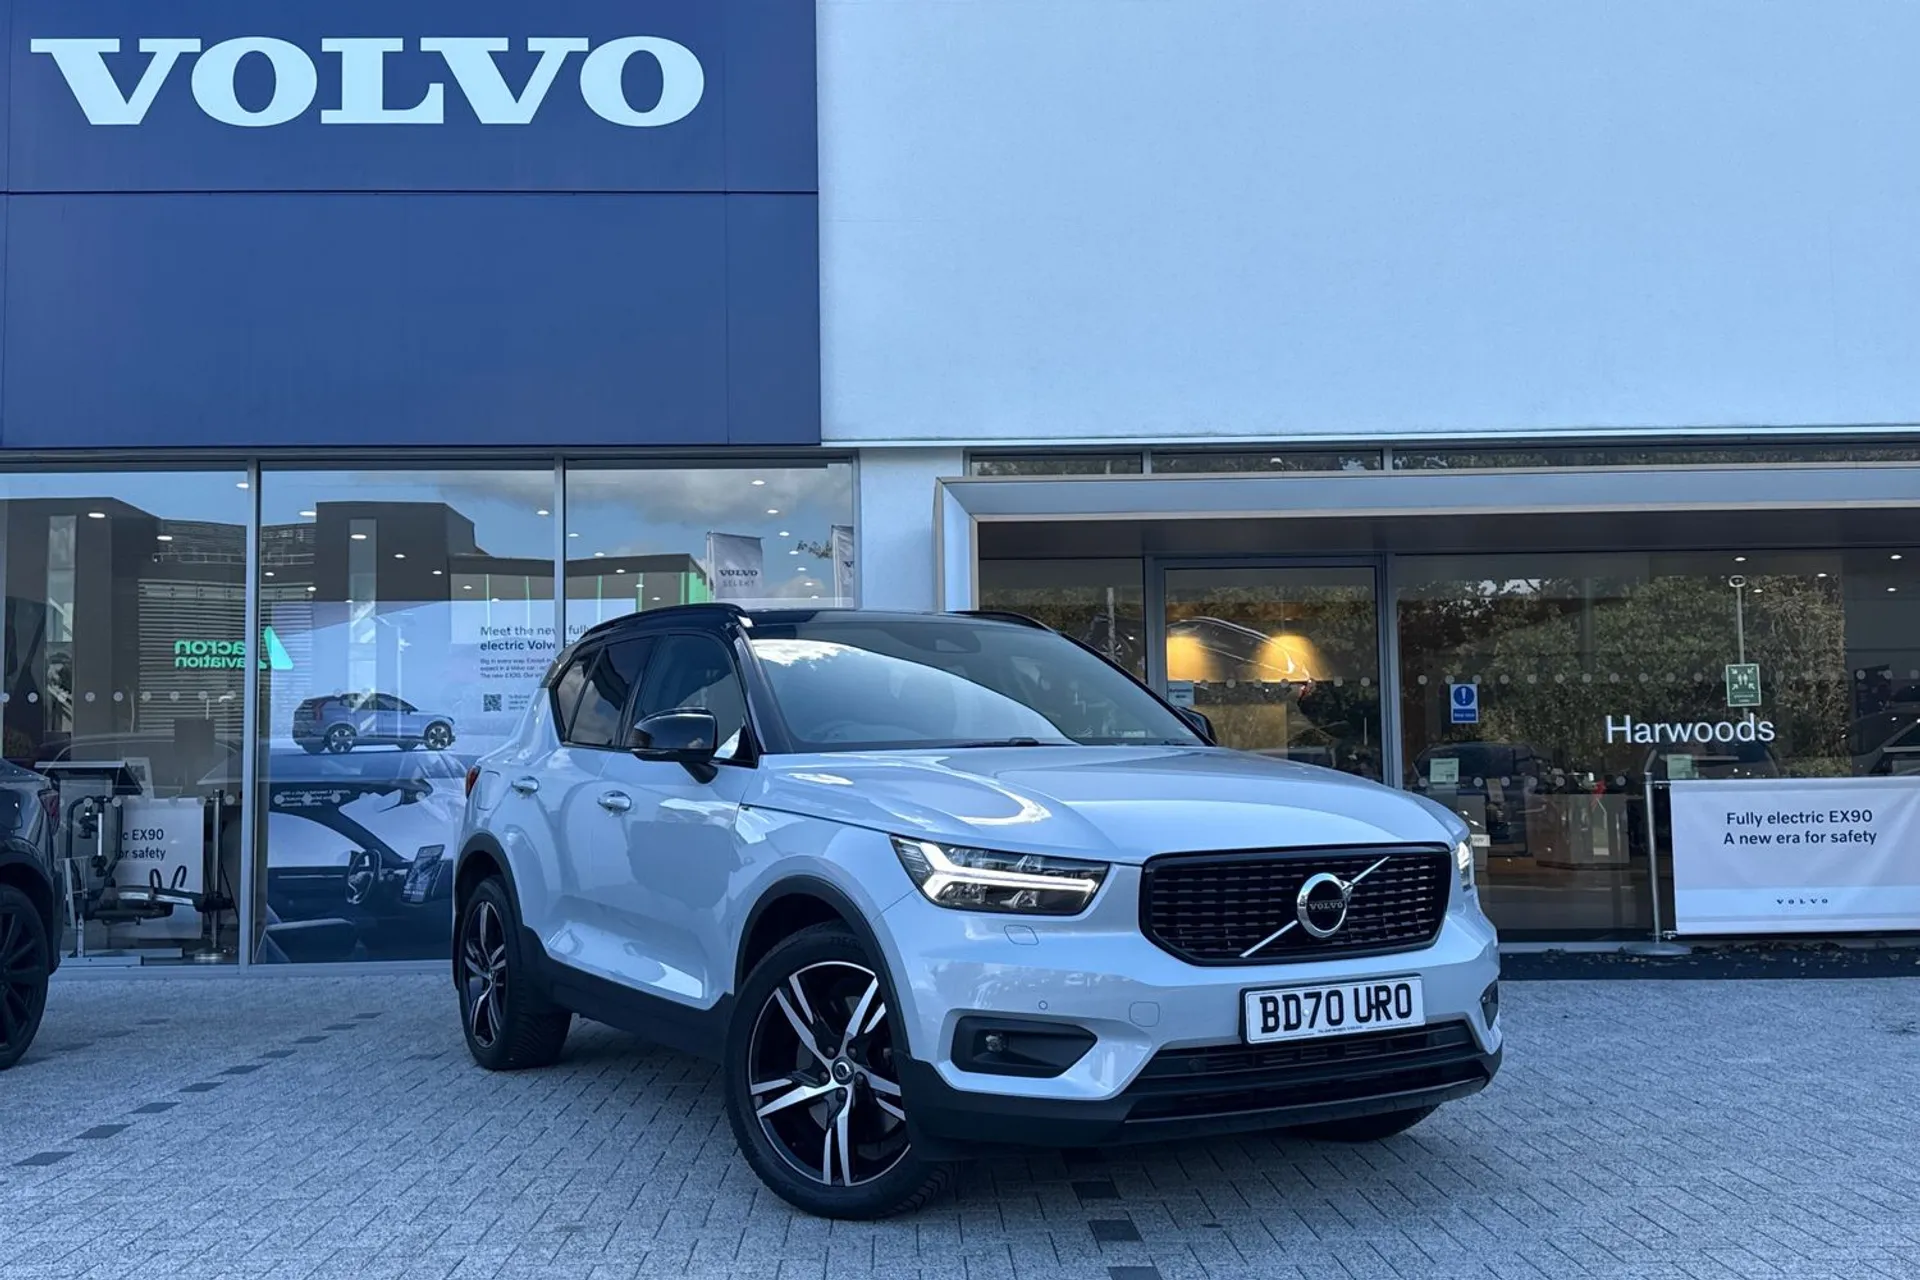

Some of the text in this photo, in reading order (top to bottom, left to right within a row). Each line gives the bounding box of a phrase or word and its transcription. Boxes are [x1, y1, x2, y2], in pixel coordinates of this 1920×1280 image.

[30, 36, 705, 127] VOLVO
[719, 569, 758, 577] VOLVO
[480, 626, 511, 636] Meet
[514, 626, 534, 636] the
[568, 624, 589, 635] full
[480, 640, 525, 651] electric
[1605, 713, 1776, 744] Harwoods
[1726, 809, 1873, 828] Fully electric EX90
[132, 828, 164, 841] EX90
[1723, 830, 1877, 846] A new era for safety
[132, 846, 167, 861] safety
[1309, 902, 1344, 911] VOLVO
[1259, 983, 1413, 1034] BD70 URO
